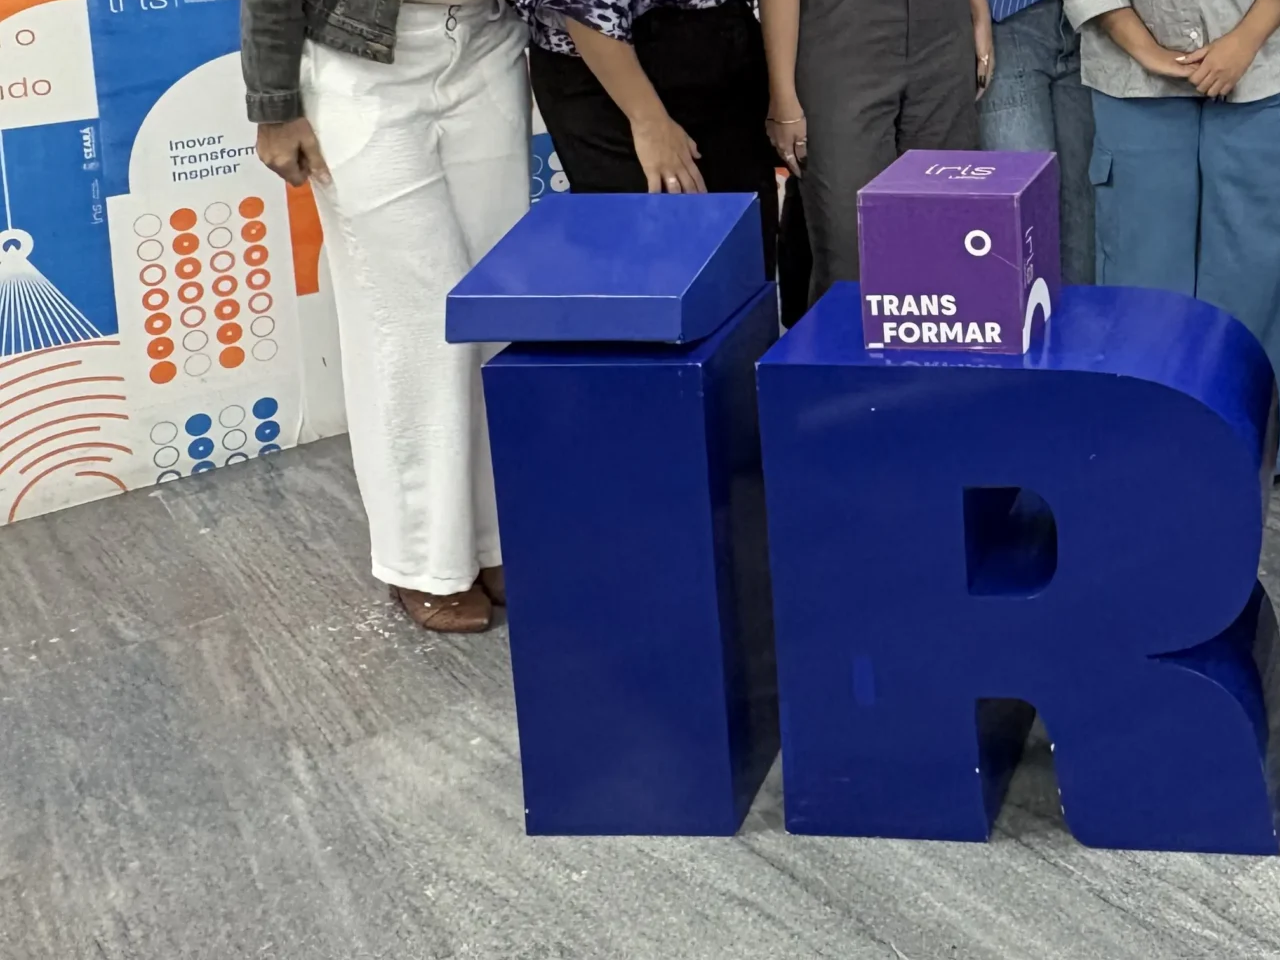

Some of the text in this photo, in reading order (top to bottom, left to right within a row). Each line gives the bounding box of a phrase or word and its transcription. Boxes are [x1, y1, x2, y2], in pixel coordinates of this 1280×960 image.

[169, 134, 224, 151] Inovar
[172, 162, 241, 183] Inspirar
[866, 294, 957, 317] TRANS
